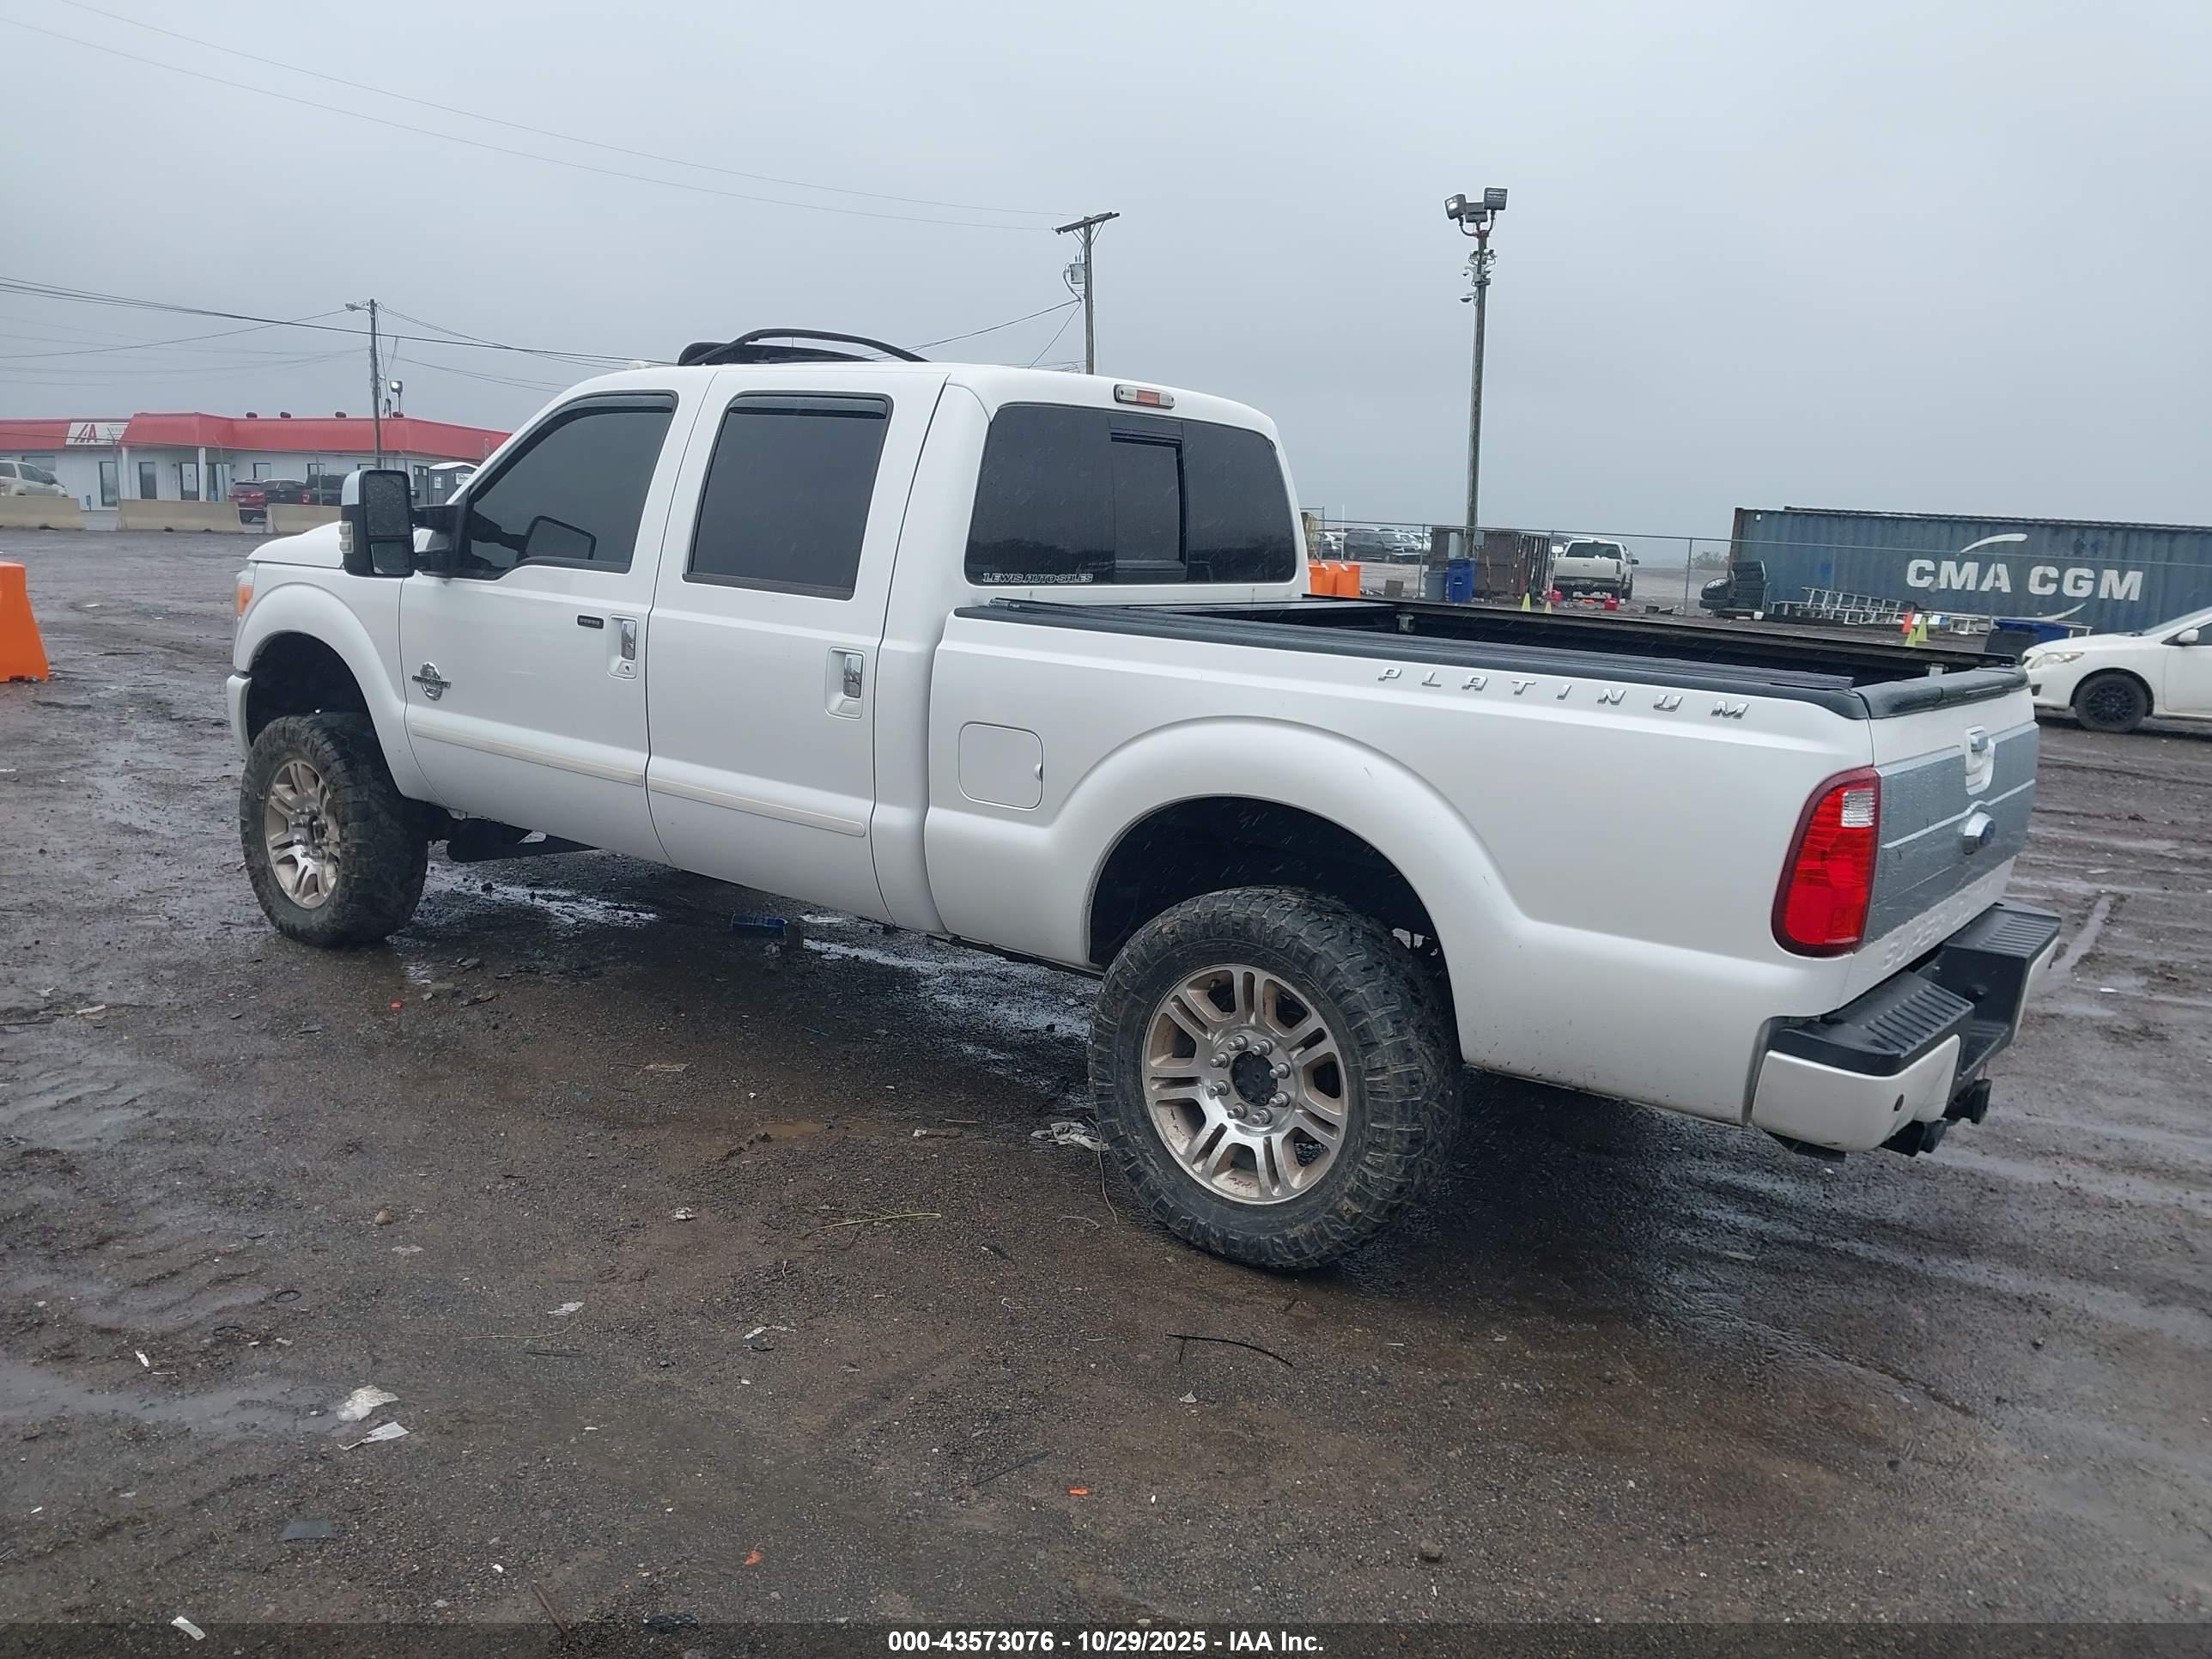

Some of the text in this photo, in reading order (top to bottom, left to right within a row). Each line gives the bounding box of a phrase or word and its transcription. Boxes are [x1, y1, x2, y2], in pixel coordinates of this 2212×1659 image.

[982, 573, 1093, 583] LEWIS AUTO SALES
[1906, 559, 2143, 601] CMA CGM
[1377, 667, 1749, 720] PLATINUM
